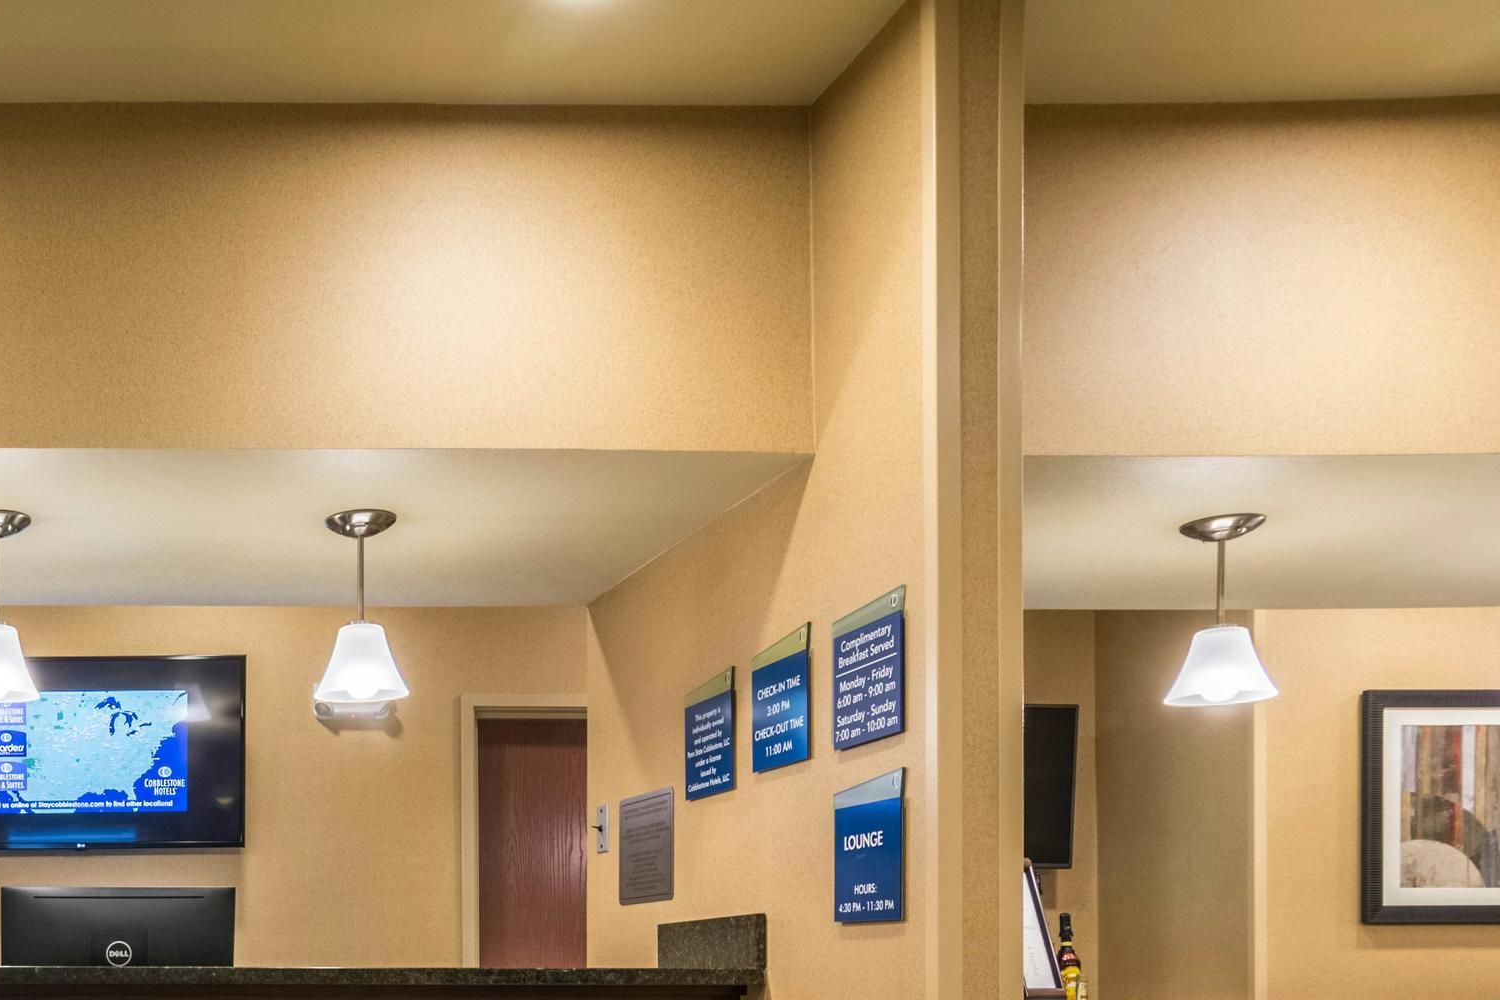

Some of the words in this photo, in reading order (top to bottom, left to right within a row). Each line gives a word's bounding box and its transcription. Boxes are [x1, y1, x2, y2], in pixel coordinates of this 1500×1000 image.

[841, 624, 892, 653] Complimentary
[839, 648, 869, 669] Breakfast
[870, 635, 894, 657] Served
[757, 681, 786, 701] CHECK-IN
[787, 675, 801, 689] TIME
[840, 675, 866, 693] Monday
[872, 665, 893, 681] Friday
[837, 695, 851, 709] 6:00
[853, 692, 863, 702] am
[868, 682, 884, 698] 9:00
[885, 681, 896, 692] am
[767, 703, 780, 717] 3:00
[781, 699, 790, 712] PM
[837, 709, 865, 727] Saturday
[871, 700, 896, 716] Sunday
[755, 721, 789, 741] CHECK-OUT
[790, 715, 804, 730] TIME
[836, 729, 850, 742] 7:00
[851, 727, 860, 738] am
[867, 717, 885, 732] 10:00
[887, 716, 898, 727] am
[766, 743, 781, 757] 11:00
[782, 740, 793, 752] AM
[145, 779, 185, 788] COBBLESTONE
[154, 787, 176, 795] HOTELS
[844, 830, 883, 851] LOUNGE
[854, 883, 877, 895] HOURS:
[839, 903, 852, 913] 4:30
[853, 902, 861, 912] PM
[867, 900, 884, 911] 11:30
[885, 900, 894, 910] PM
[109, 950, 129, 958] DELL
